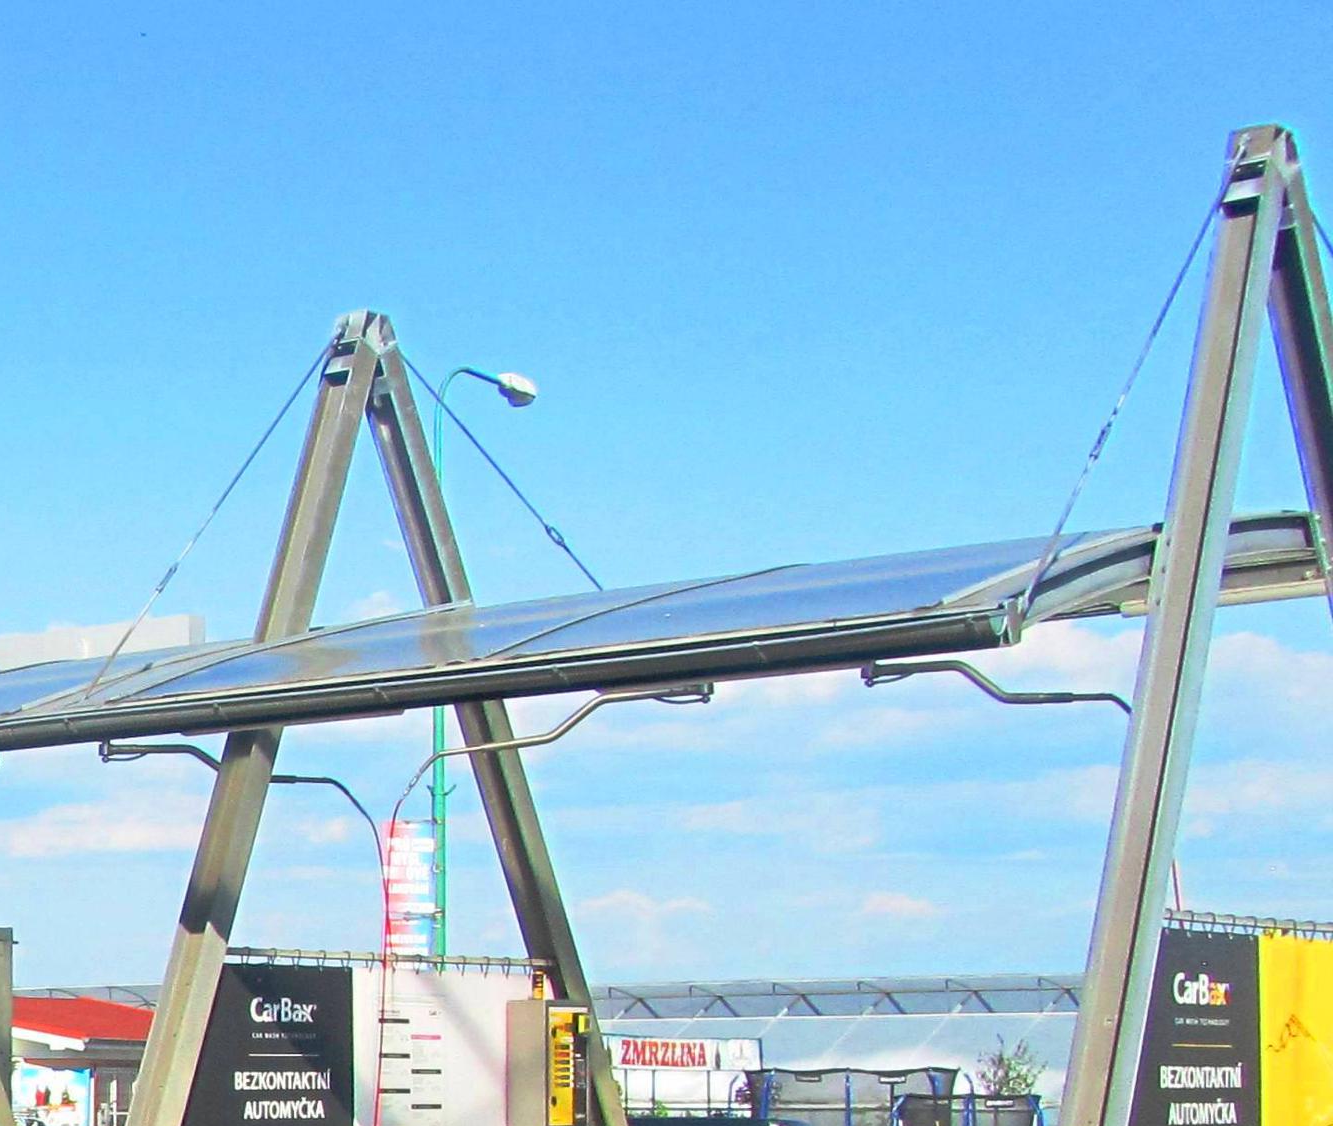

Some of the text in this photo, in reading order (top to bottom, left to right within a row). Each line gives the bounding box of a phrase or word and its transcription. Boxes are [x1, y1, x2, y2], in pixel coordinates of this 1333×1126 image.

[1172, 972, 1230, 1007] CarBax
[250, 996, 316, 1023] CarBax
[621, 1039, 707, 1067] ZMRZLINA
[234, 1068, 331, 1091] BEZKONTAKTNÍ
[1159, 1062, 1243, 1089] BEZKONTAKTNÍ
[243, 1096, 326, 1119] AUTOMYČKA
[1167, 1098, 1238, 1126] AUTOMYČKA
